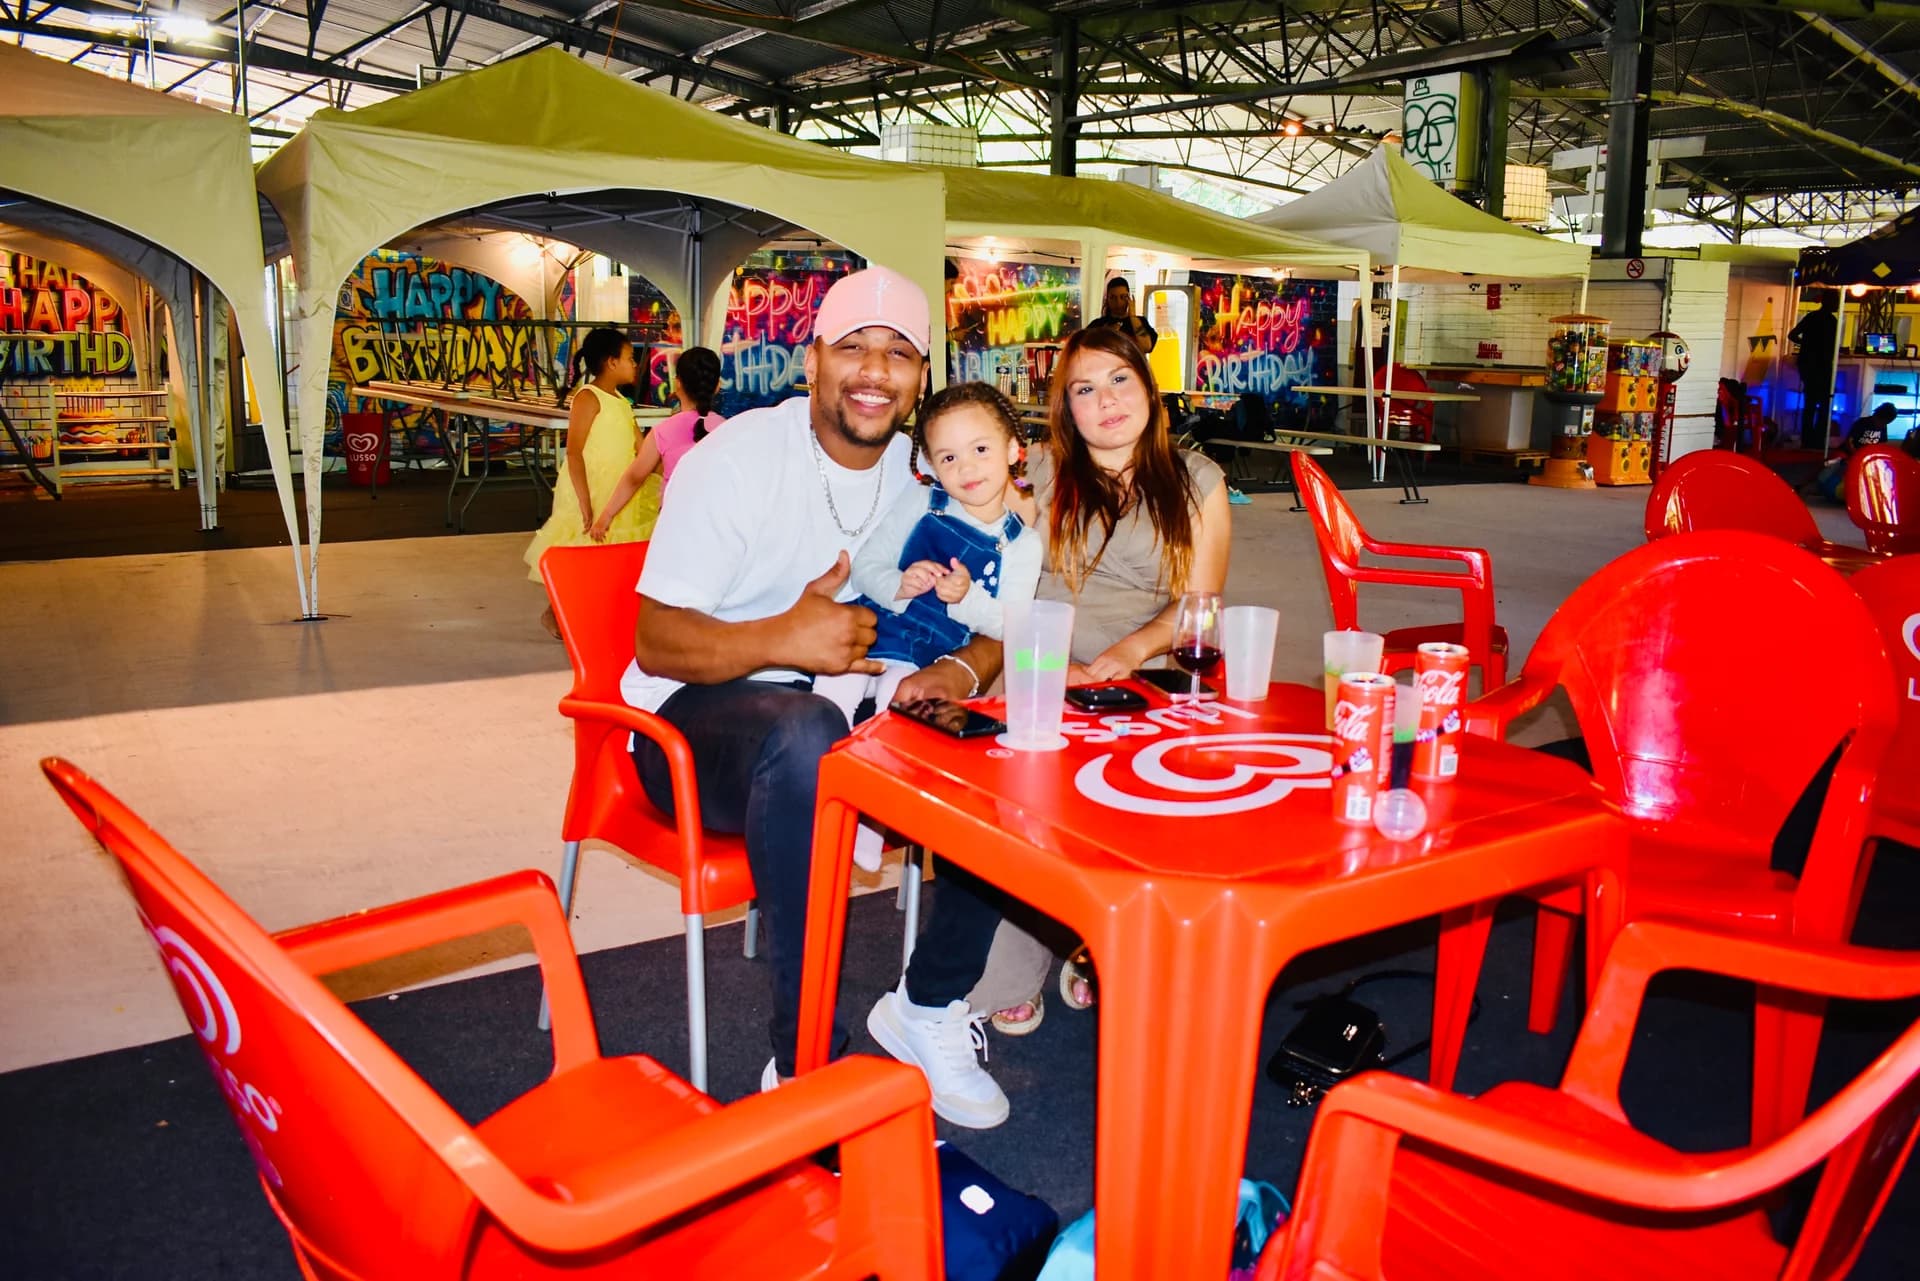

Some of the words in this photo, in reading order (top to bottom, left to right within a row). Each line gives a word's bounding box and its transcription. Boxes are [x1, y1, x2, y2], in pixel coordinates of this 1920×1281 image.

[0, 287, 131, 332] HAPP
[371, 267, 503, 334] HAPPY
[988, 303, 1064, 346] HAPPY
